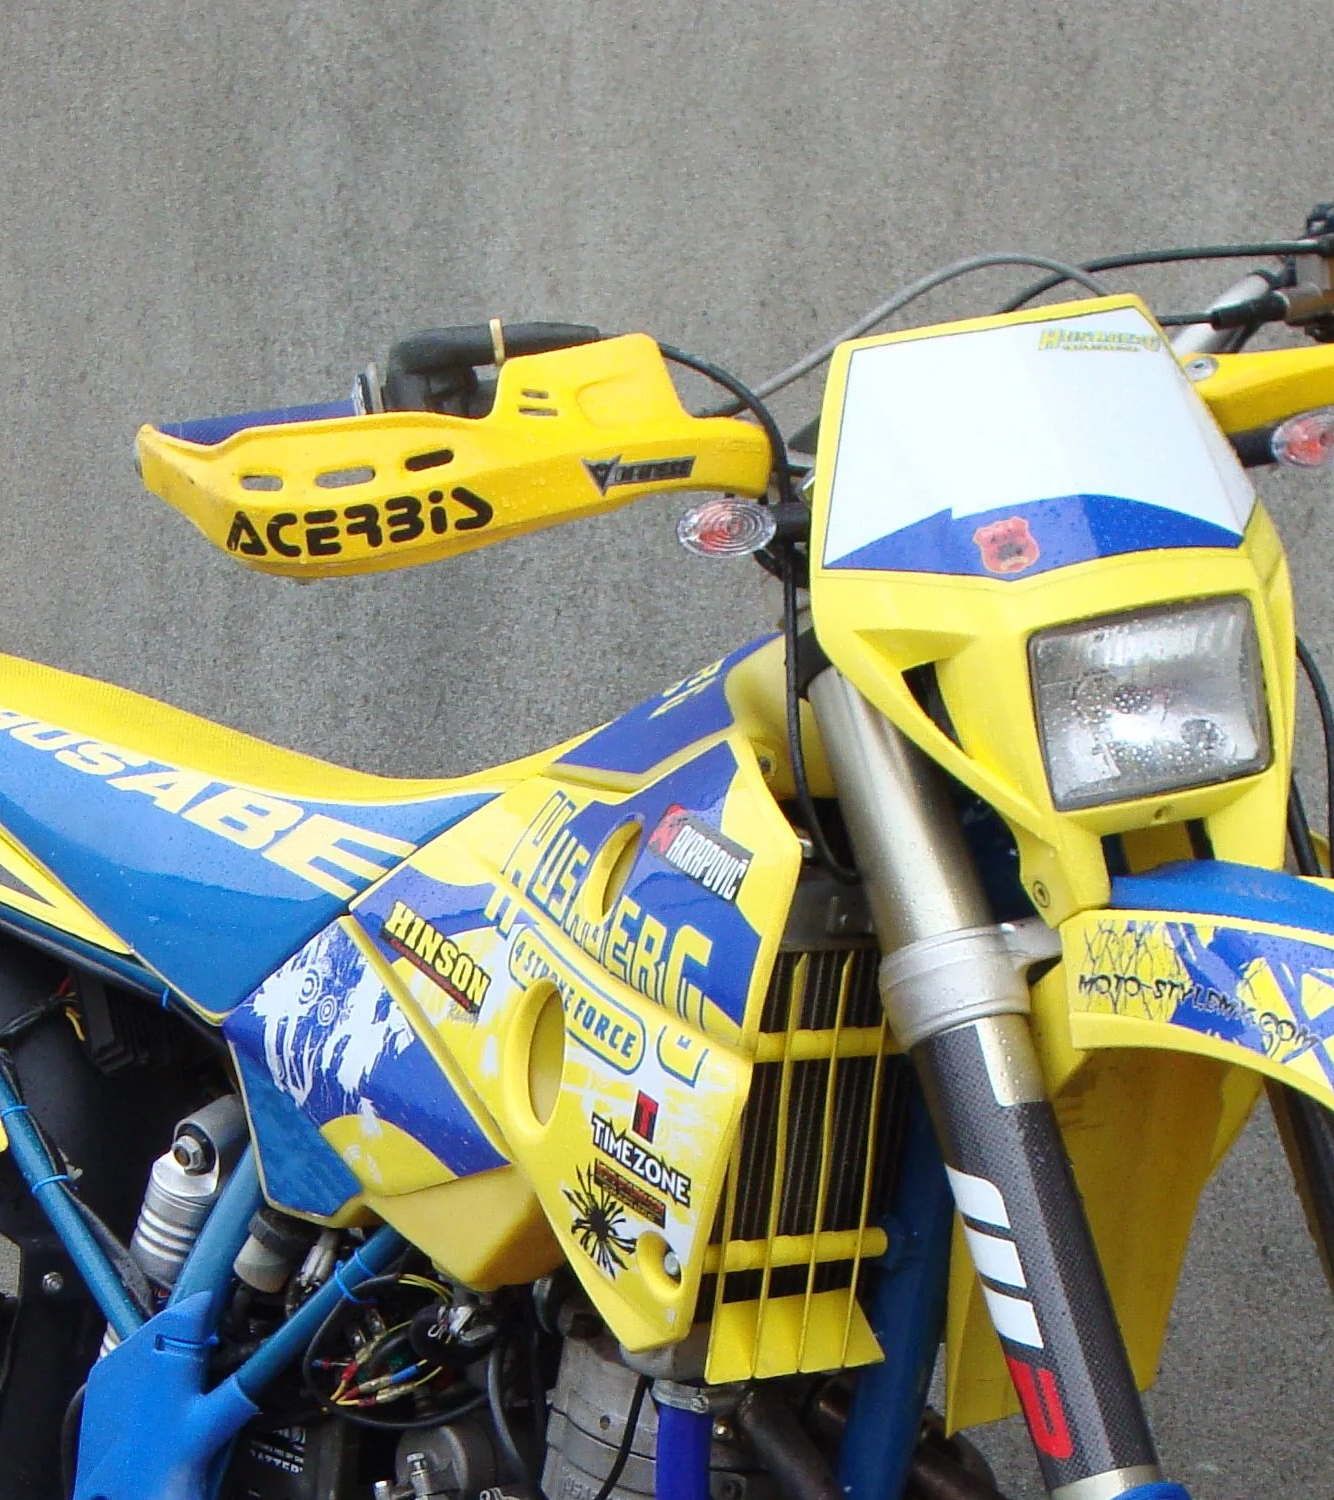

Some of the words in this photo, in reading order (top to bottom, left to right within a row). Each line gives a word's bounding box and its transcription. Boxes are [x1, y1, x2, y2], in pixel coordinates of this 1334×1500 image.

[382, 898, 492, 1009] HINSON
[573, 996, 637, 1058] FORCE
[592, 1113, 691, 1207] TIMEZONE
